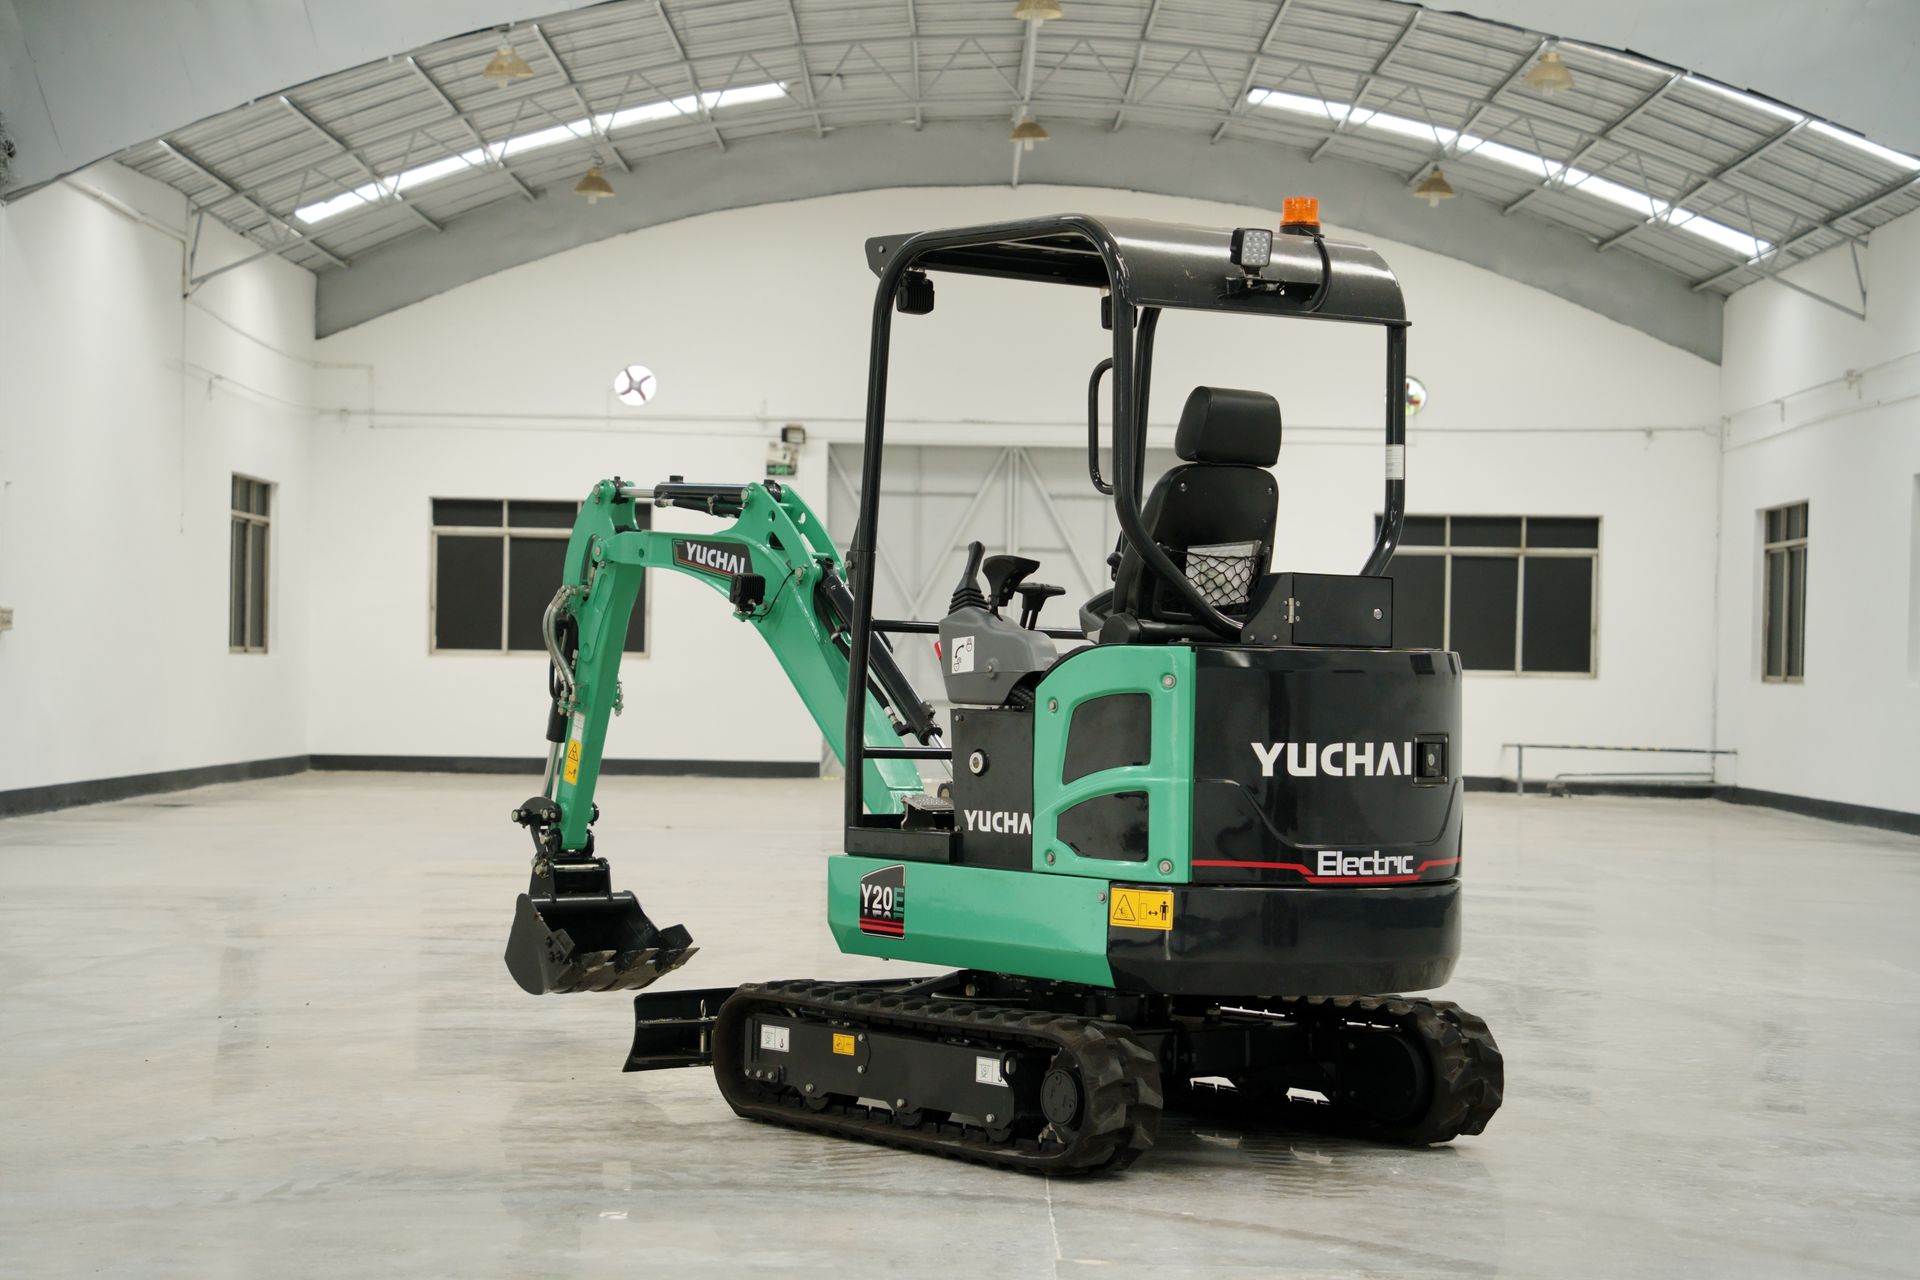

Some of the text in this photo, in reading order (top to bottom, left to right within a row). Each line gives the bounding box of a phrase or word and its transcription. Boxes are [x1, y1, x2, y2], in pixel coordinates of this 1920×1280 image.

[686, 541, 746, 575] YUCHAI
[1250, 742, 1412, 777] YUCHAI
[963, 809, 1032, 835] YUCHA
[1317, 850, 1414, 876] Electric
[861, 883, 905, 912] Y20E
